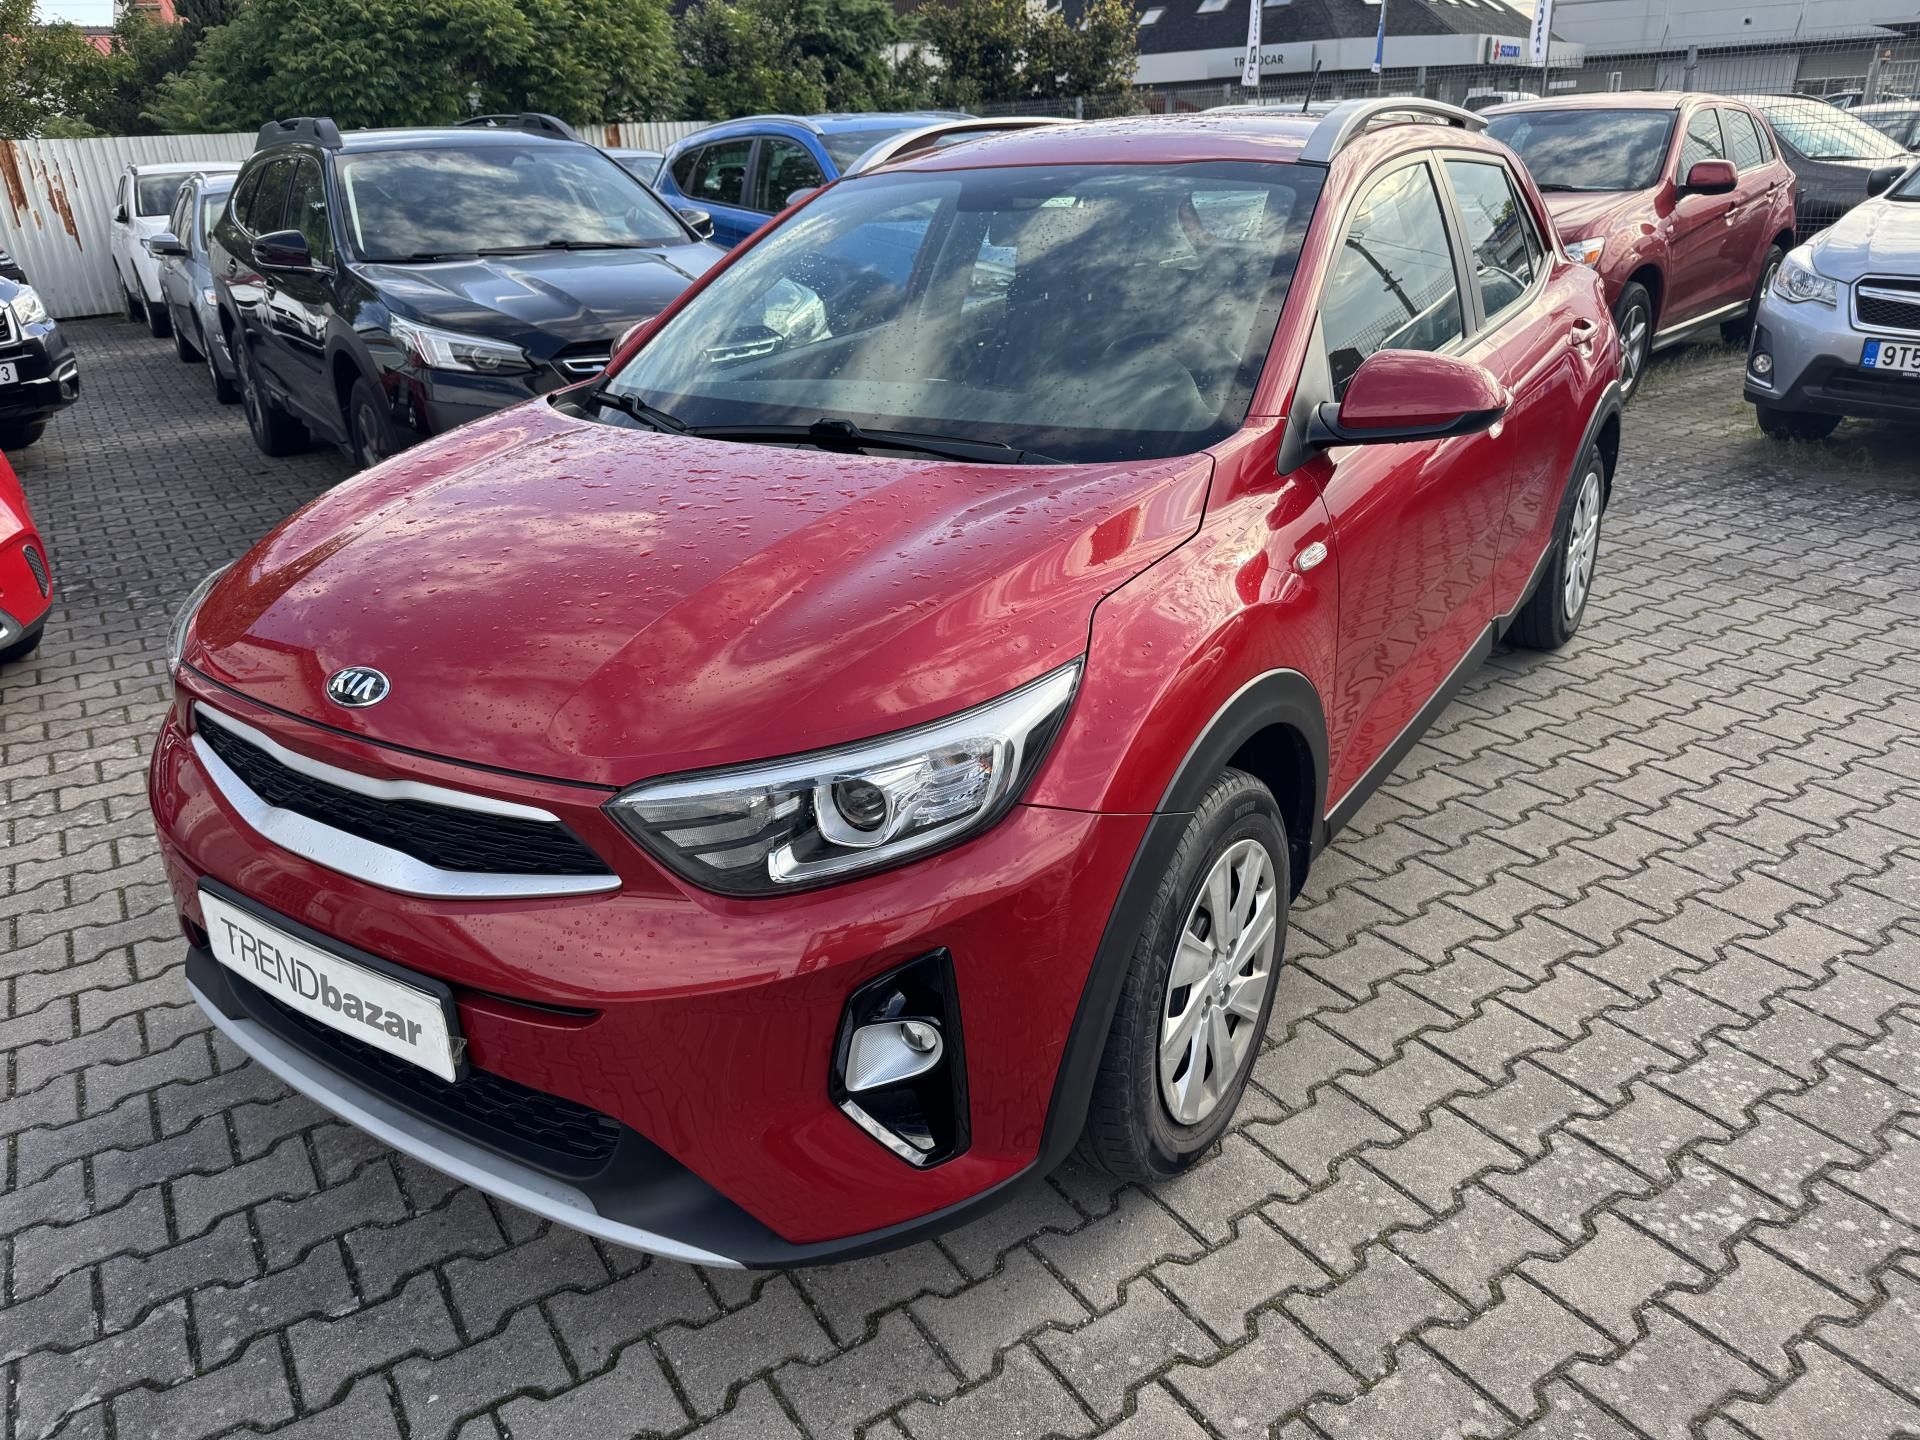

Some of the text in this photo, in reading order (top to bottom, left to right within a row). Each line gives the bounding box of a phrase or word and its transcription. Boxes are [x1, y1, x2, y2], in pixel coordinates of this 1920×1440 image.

[1234, 54, 1284, 68] TRDCAR
[1863, 357, 1875, 365] CZ
[331, 671, 376, 700] KIA
[220, 916, 423, 1046] TRENDbazar
